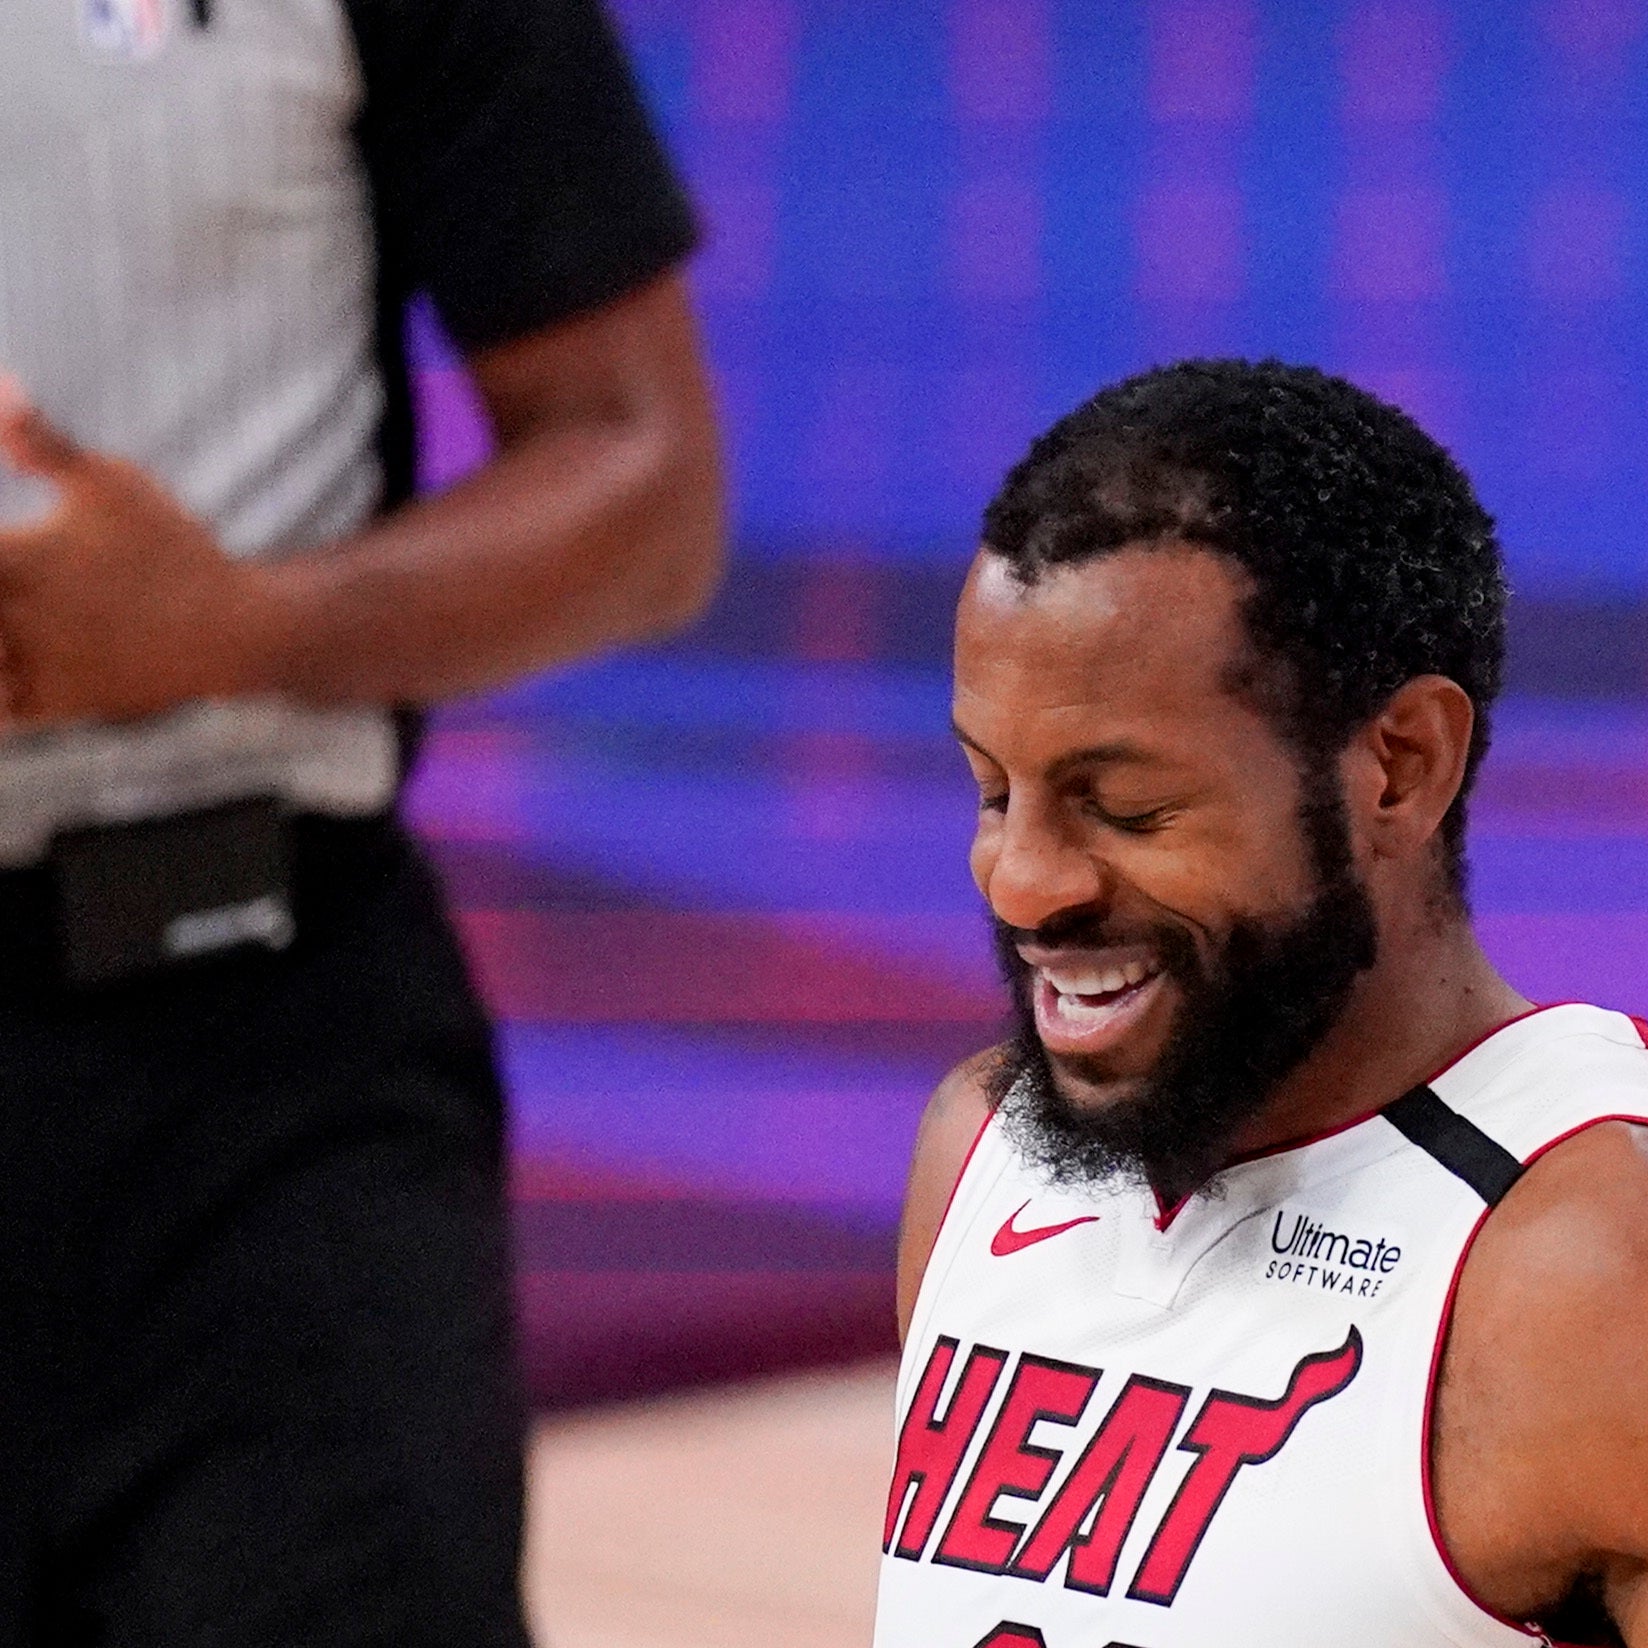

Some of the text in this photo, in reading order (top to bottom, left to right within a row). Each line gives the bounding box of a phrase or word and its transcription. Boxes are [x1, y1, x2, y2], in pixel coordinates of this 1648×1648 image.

[1271, 1210, 1402, 1274] Ultimate
[1265, 1260, 1384, 1298] SOFTWARE
[881, 1322, 1364, 1608] HEAT
